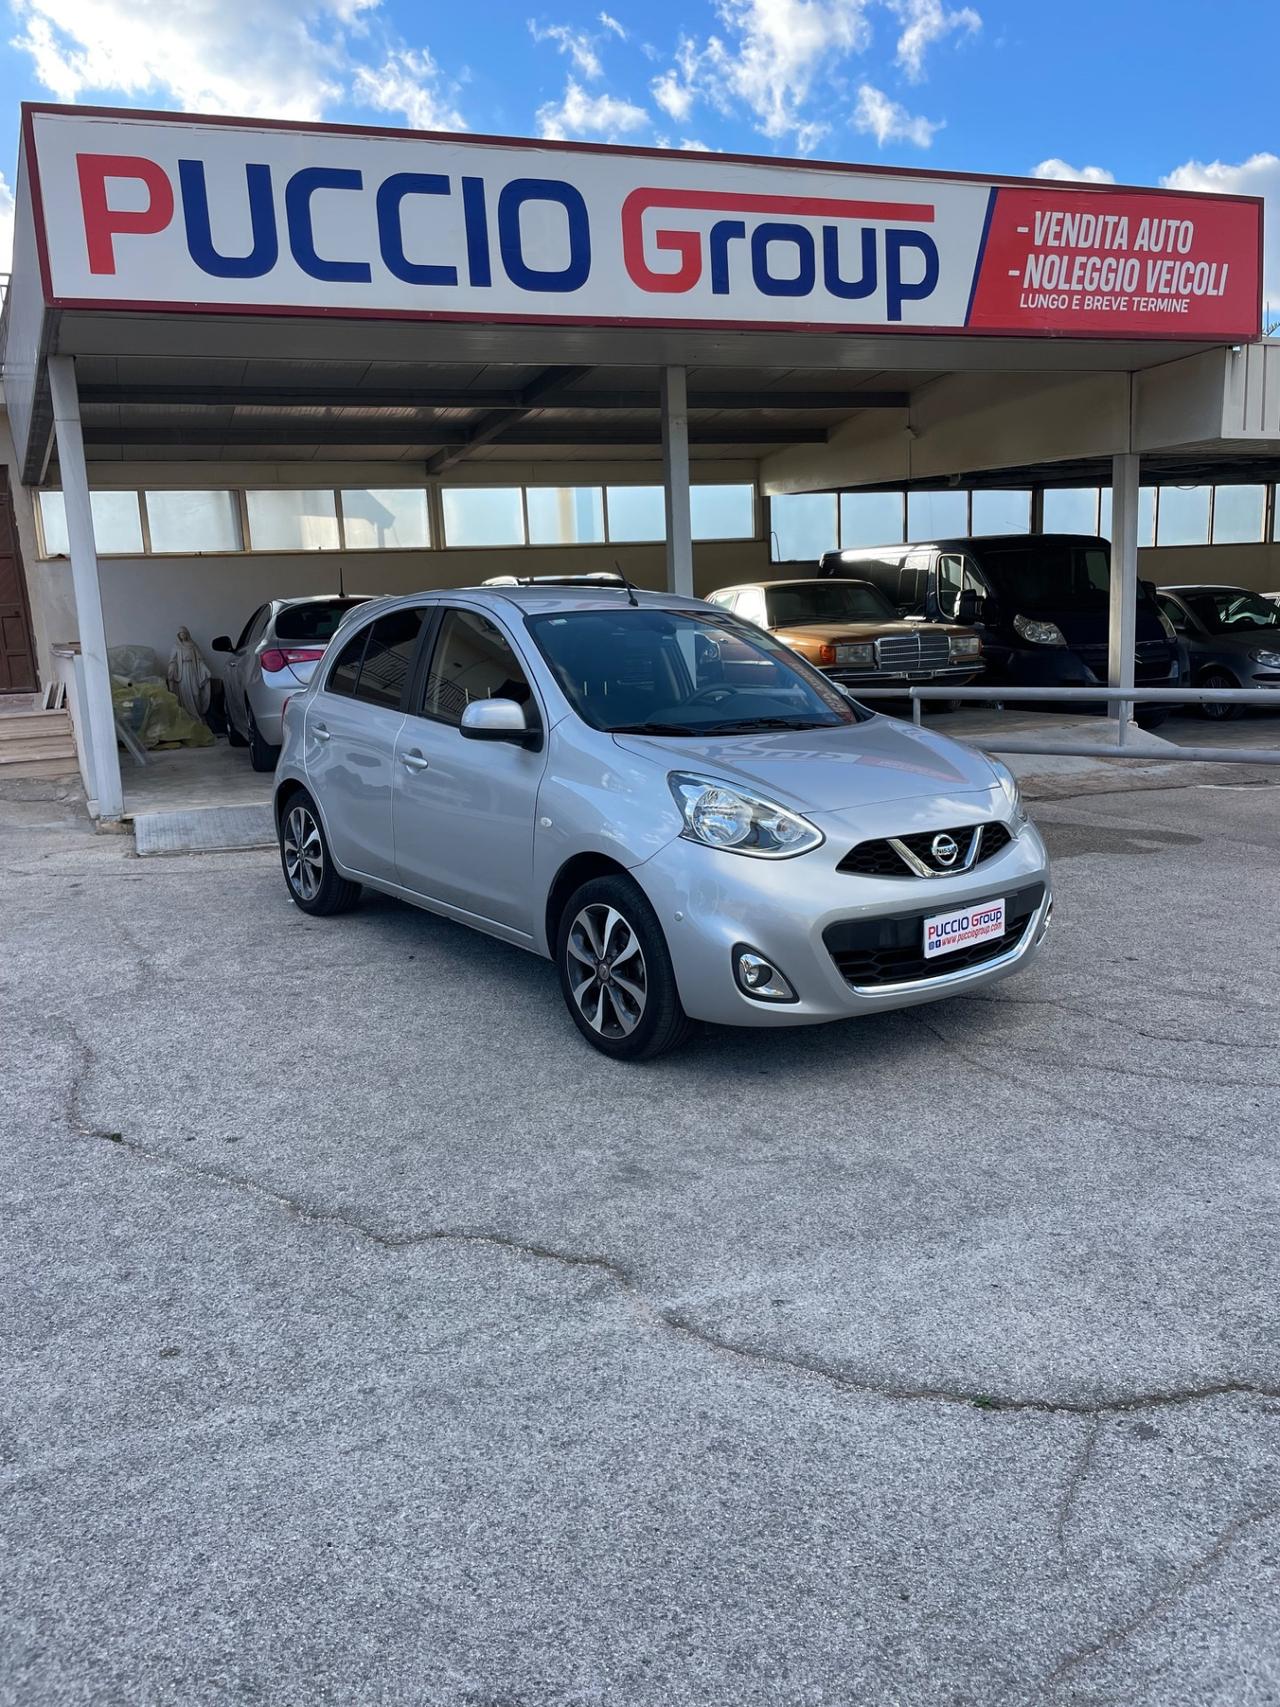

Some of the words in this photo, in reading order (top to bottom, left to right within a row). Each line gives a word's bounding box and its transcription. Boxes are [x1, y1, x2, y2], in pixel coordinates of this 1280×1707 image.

[76, 153, 591, 292] PUCCIO
[621, 187, 938, 321] Group
[1133, 218, 1194, 254] AUTO
[1146, 260, 1229, 296] VEICOLI
[1020, 294, 1069, 309] LUNGO
[1072, 296, 1080, 310] E
[1084, 297, 1128, 311] BREVE
[1132, 298, 1190, 313] TERMINE
[928, 916, 969, 940] PUCCIO
[971, 907, 1002, 927] Group
